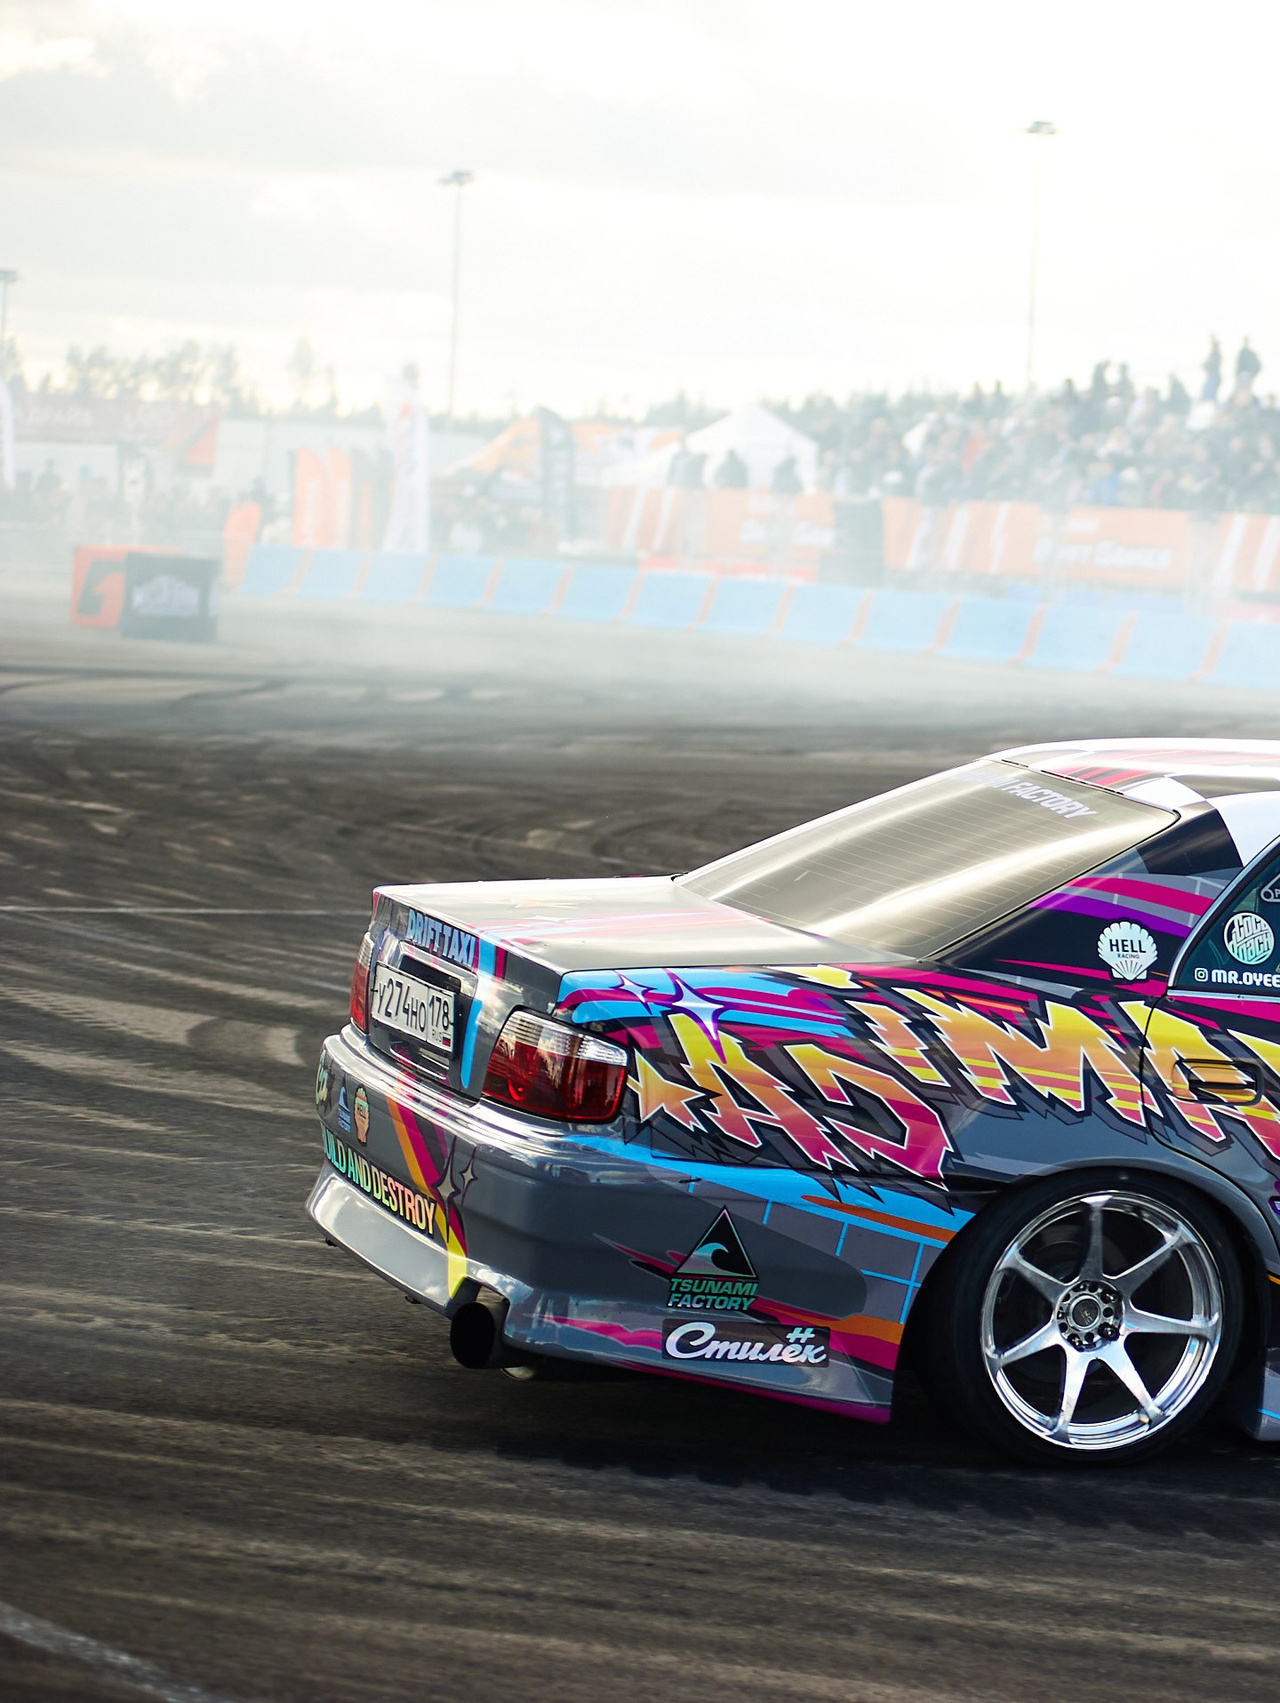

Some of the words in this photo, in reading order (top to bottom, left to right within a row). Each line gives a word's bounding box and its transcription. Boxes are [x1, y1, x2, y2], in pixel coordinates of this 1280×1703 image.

[406, 909, 443, 951] DRIFT
[442, 927, 476, 967] TAXI
[1109, 938, 1147, 954] HELL
[429, 995, 450, 1031] 178
[347, 1147, 373, 1194] AND
[371, 1165, 437, 1235] DESTROY
[670, 1278, 759, 1296] TSUNAMI
[667, 1293, 755, 1311] FACTORY
